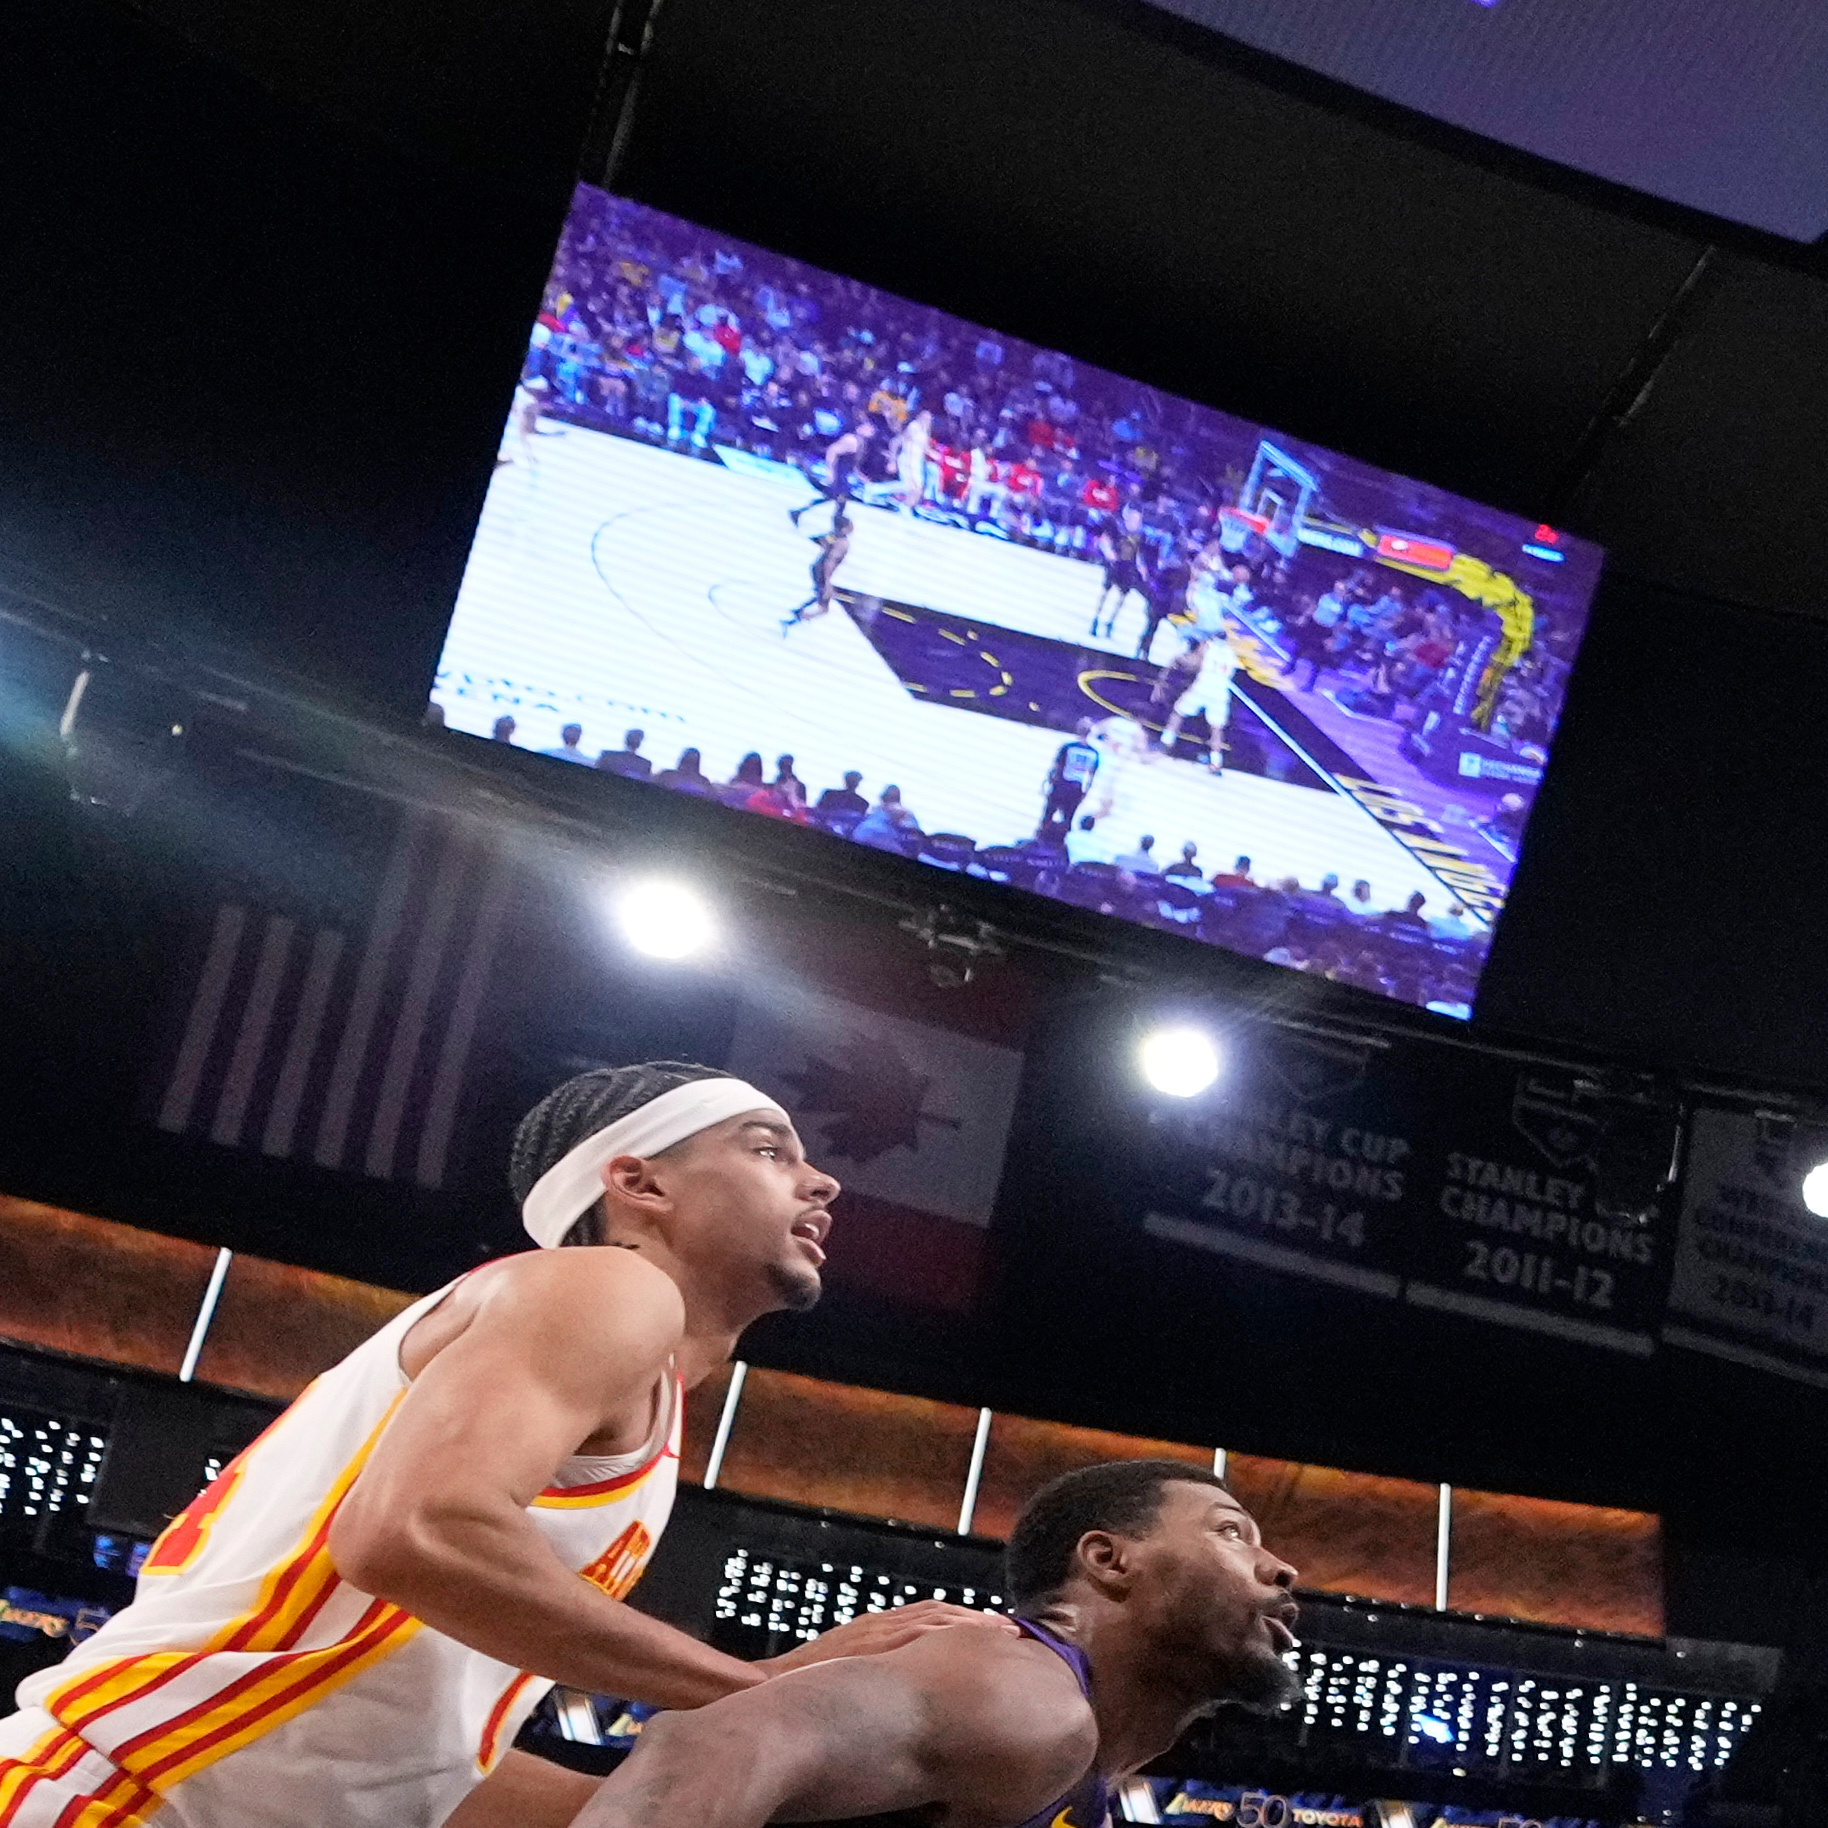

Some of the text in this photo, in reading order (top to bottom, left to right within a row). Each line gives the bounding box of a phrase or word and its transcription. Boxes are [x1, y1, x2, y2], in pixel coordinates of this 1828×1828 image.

[1445, 1152, 1589, 1210] STANLEY
[1438, 1185, 1656, 1265] CHAMPIONS
[1462, 1240, 1618, 1308] 2011-12
[1292, 1808, 1364, 1828] TOYOTA
